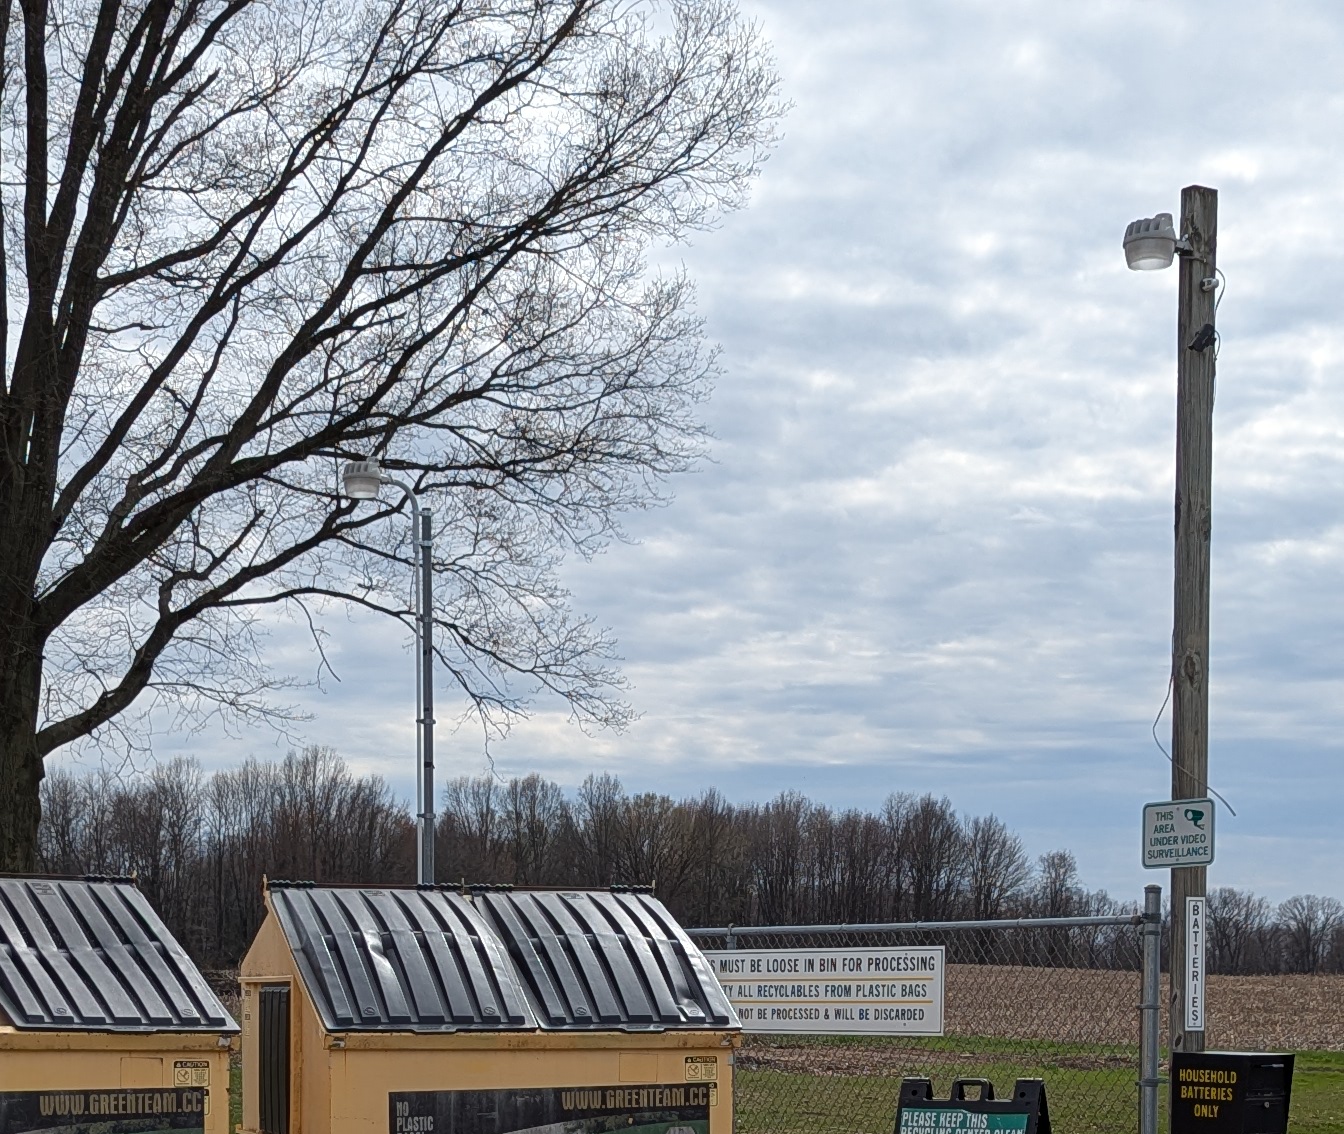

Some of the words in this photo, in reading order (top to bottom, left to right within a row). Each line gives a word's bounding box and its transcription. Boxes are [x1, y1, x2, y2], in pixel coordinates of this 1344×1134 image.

[1155, 811, 1174, 821] THIS
[1153, 823, 1175, 834] AREA
[1150, 836, 1179, 847] UNDER
[1180, 833, 1207, 844] VIDEO
[1147, 846, 1209, 860] SURVEILLANCE
[719, 959, 746, 973] MUST
[750, 958, 763, 973] BE
[766, 958, 800, 973] LOOSE
[804, 958, 815, 972] IN
[819, 957, 837, 972] BIN
[842, 957, 863, 972] FOR
[867, 956, 935, 972] PROCESSING
[1191, 904, 1200, 1021] BATTERIES
[737, 985, 753, 998] ALL
[757, 984, 820, 998] RECYCLABLES
[824, 984, 852, 998] FROM
[855, 984, 897, 998] PLASTIC
[900, 983, 927, 998] BAGS
[738, 1008, 754, 1020] NOT
[757, 1008, 767, 1020] BE
[771, 1008, 820, 1020] PROCESSED
[823, 1008, 830, 1020] &
[834, 1008, 855, 1020] WILL
[858, 1008, 870, 1020] BE
[873, 1008, 925, 1021] DISCARDED
[1179, 1068, 1237, 1084] HOUSEHOLD
[561, 1087, 708, 1110] WWW.GREENTEAM.CC
[1180, 1085, 1233, 1101] BATTERIES
[39, 1091, 203, 1117] WWW.GREENTEAM.CC
[396, 1101, 409, 1117] NO
[1194, 1103, 1219, 1118] ONLY
[396, 1115, 434, 1132] PLASTIC
[902, 1111, 937, 1127] PLEASE
[939, 1112, 963, 1128] KEEP
[966, 1113, 988, 1128] THIS
